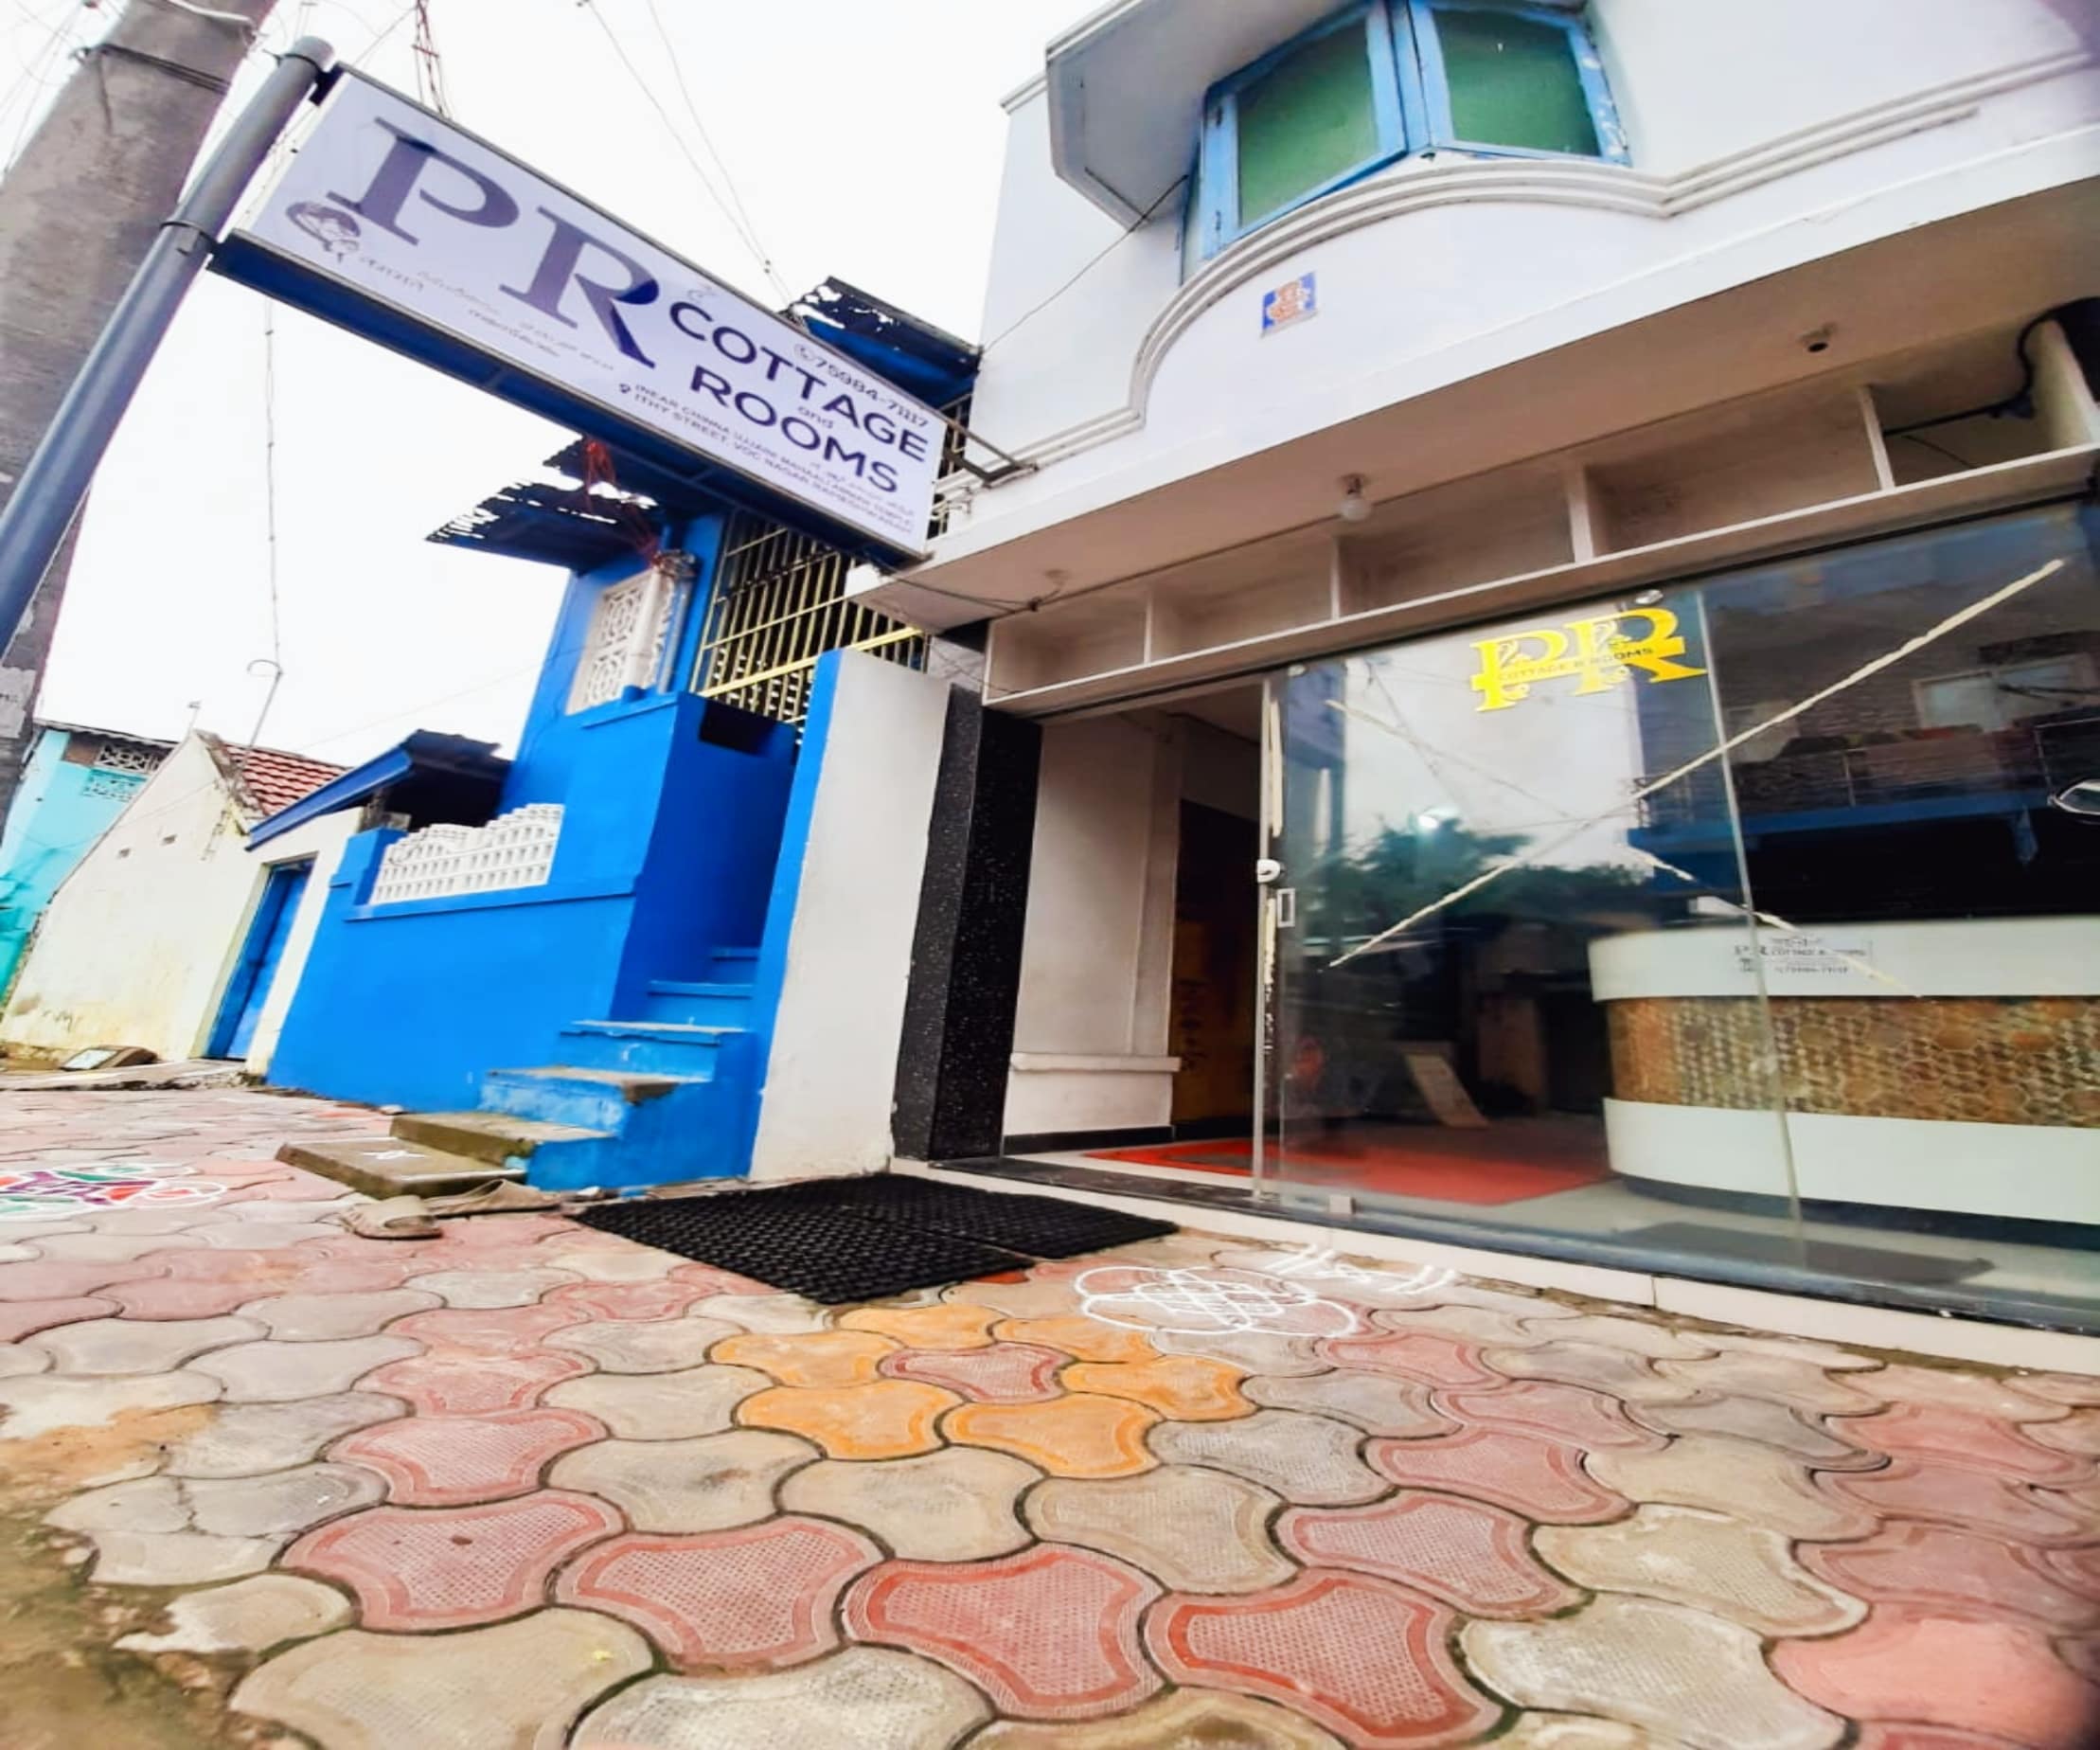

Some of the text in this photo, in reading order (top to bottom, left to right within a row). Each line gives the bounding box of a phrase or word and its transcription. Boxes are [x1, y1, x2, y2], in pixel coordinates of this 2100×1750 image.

[667, 300, 929, 464] COTTAGE
[689, 365, 899, 493] ROOMS
[797, 405, 834, 429] and
